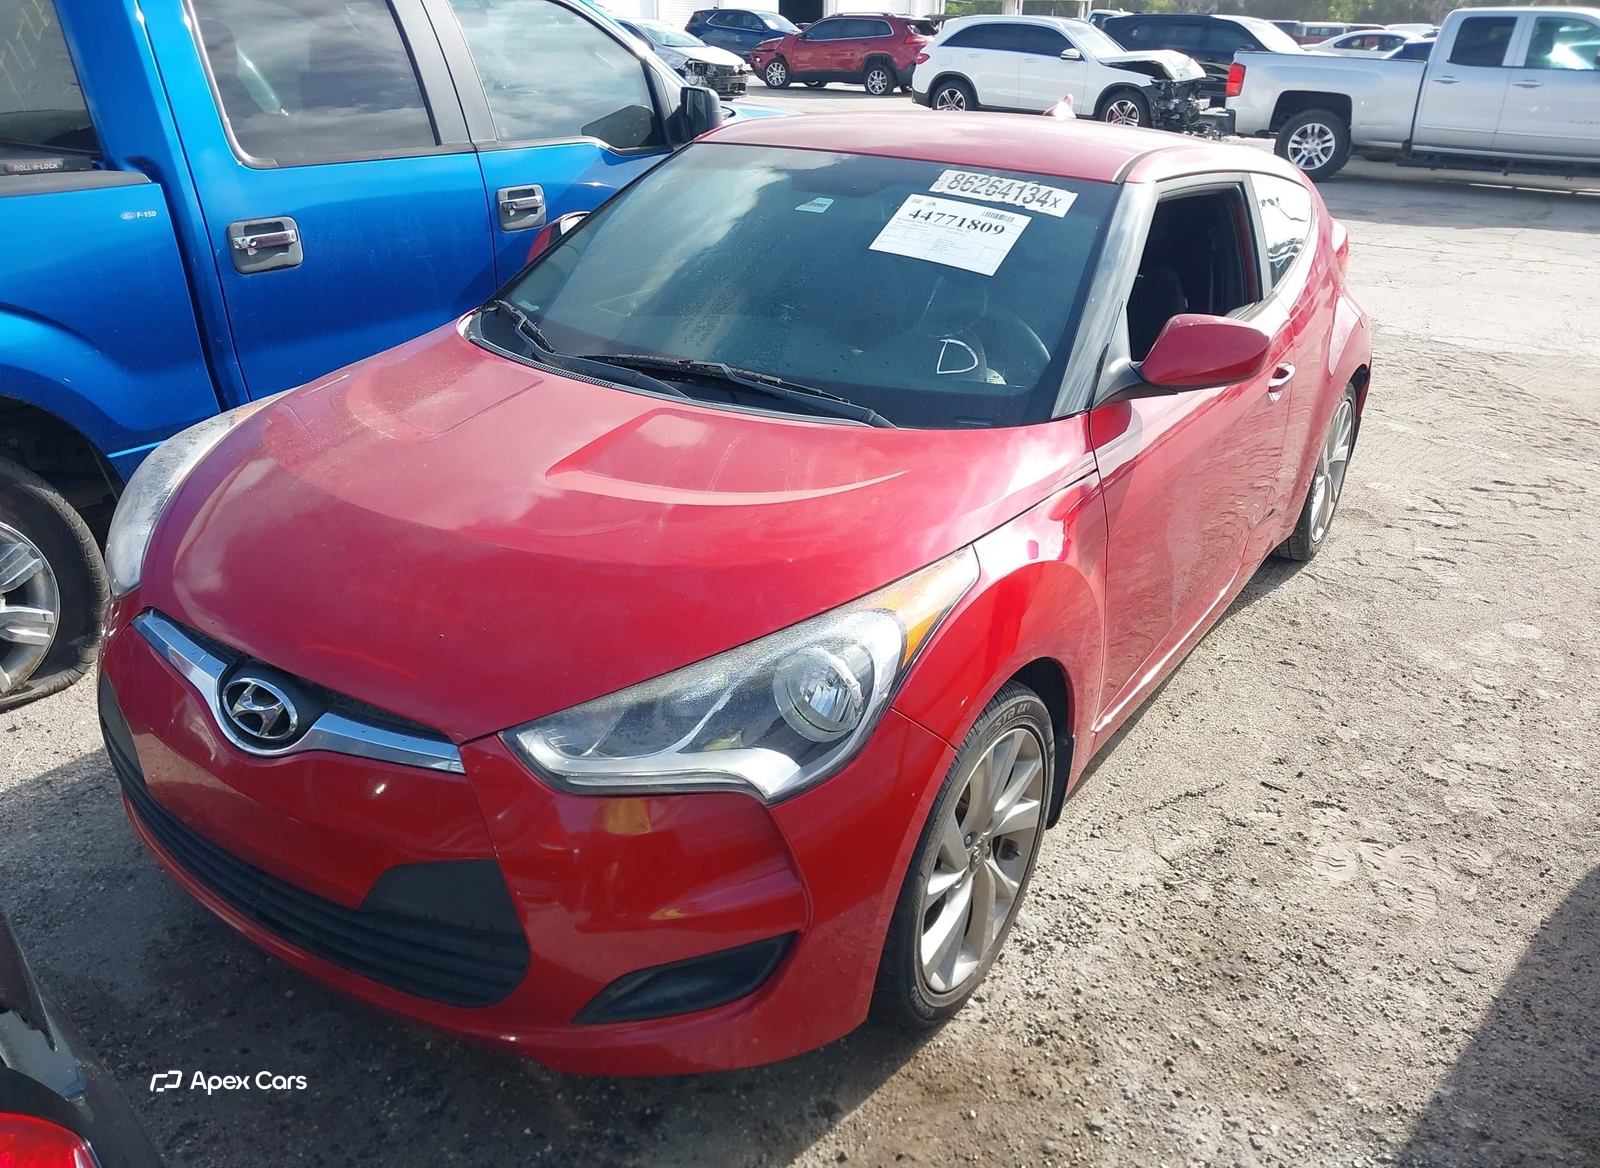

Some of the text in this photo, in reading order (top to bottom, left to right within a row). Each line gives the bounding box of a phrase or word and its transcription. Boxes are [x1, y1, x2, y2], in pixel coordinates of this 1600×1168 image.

[13, 162, 59, 172] ROLL-N-LOCK
[136, 210, 157, 219] F-150
[908, 209, 1006, 235] 44771809
[936, 338, 979, 375] D
